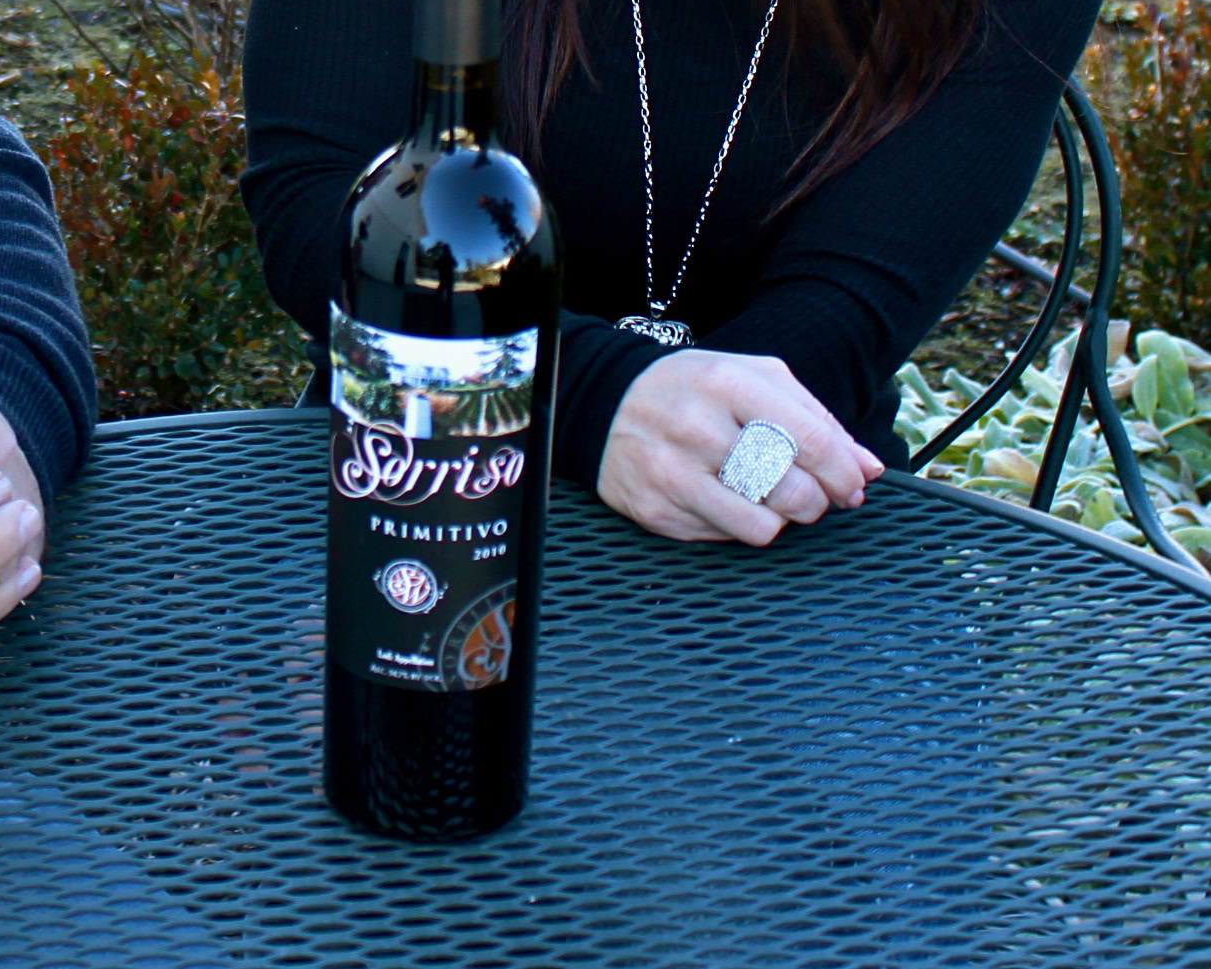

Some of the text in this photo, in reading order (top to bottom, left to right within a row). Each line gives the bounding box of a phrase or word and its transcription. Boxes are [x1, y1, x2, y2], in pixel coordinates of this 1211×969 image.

[331, 421, 525, 506] Sorriso
[370, 515, 509, 542] PRIMITIVO
[472, 543, 507, 563] 2010
